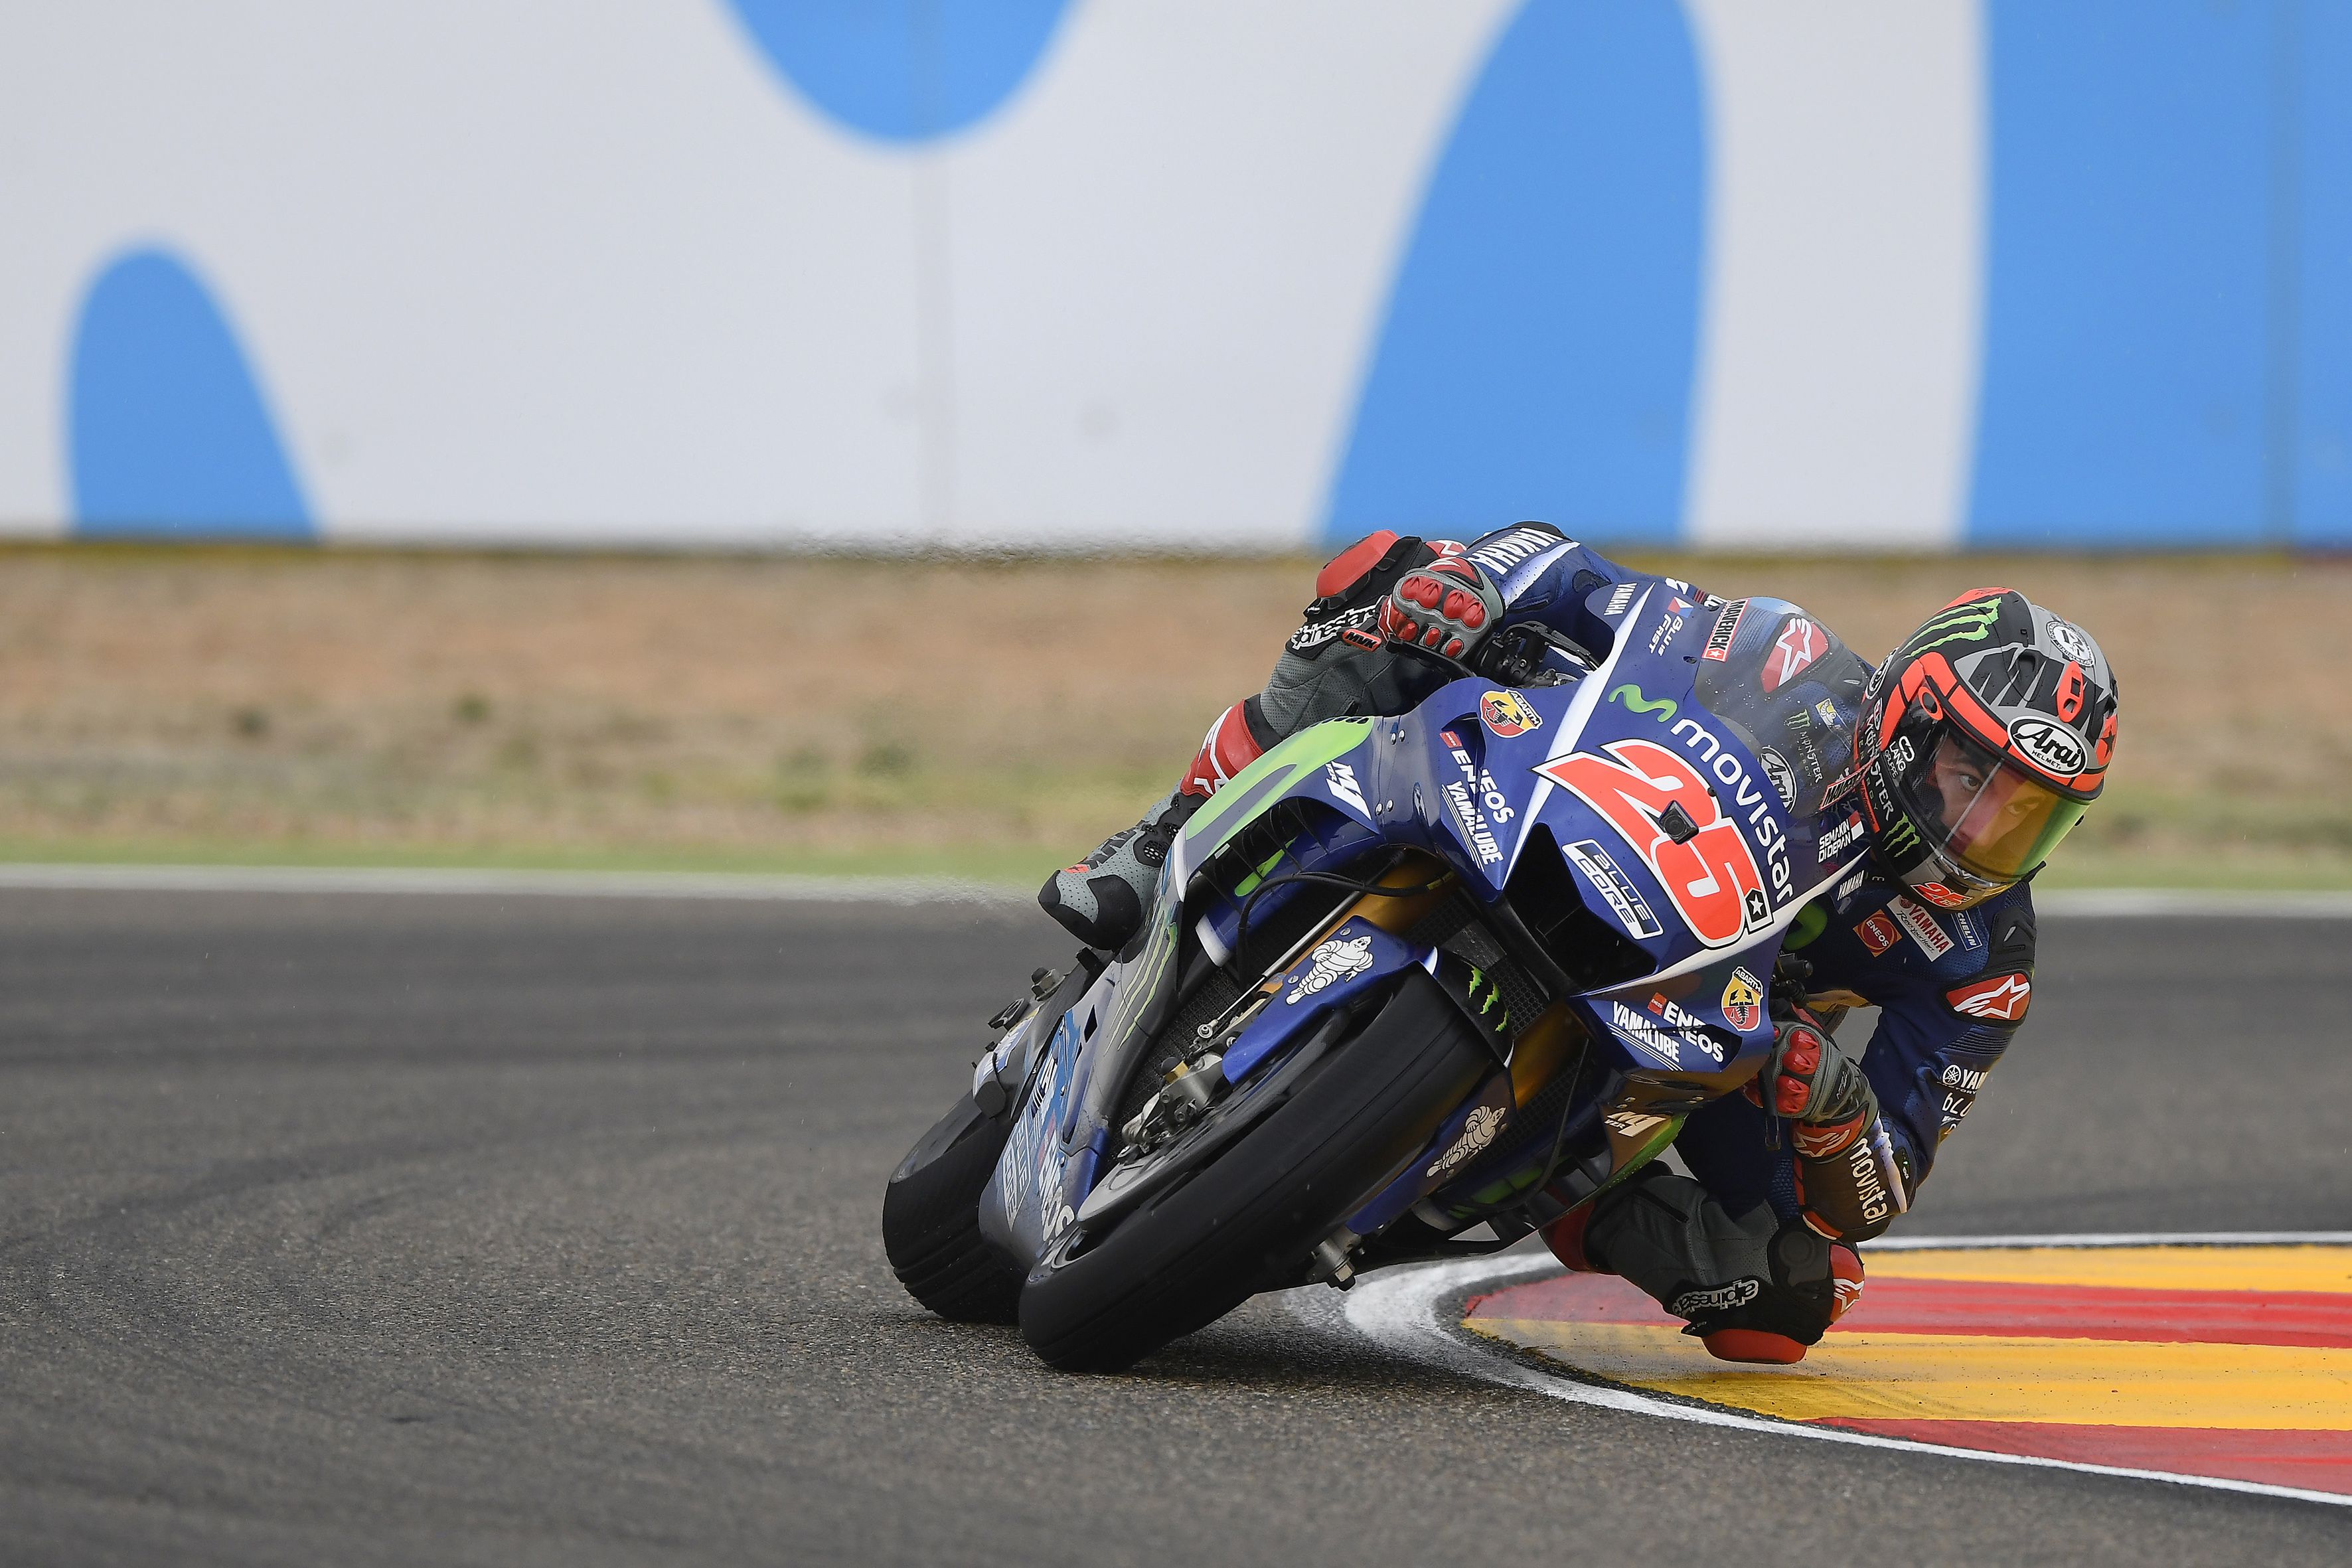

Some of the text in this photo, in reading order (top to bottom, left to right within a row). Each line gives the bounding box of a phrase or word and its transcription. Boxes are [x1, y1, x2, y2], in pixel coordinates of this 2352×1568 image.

[1604, 583, 1637, 615] YAMAHA
[1345, 631, 1377, 649] MVK
[1648, 613, 1672, 654] FAST
[1708, 599, 1747, 651] MAVERICK
[1510, 692, 1539, 725] ABARTH
[2014, 727, 2082, 767] Arai
[2031, 750, 2061, 768] HELMET
[1451, 749, 1515, 824] ENEOS
[1447, 781, 1504, 865] YAMALUBE
[1670, 718, 1794, 903] movistar
[1529, 738, 1769, 949] 25
[1819, 818, 1849, 850] SEMAKIN
[1577, 858, 1636, 924] CORE
[1593, 853, 1651, 921] BLUE
[1866, 919, 1889, 947] ENEOS
[1896, 910, 1913, 930] Revs
[1909, 905, 1950, 953] YAMAHA
[1957, 912, 1977, 947] CHELIN
[1735, 969, 1761, 992] ABARTH
[1651, 998, 1663, 1010] ENEOS
[1612, 1000, 1680, 1063] YAMALUBE
[1663, 1000, 1724, 1063] ENEOS
[1607, 1111, 1667, 1137] M1
